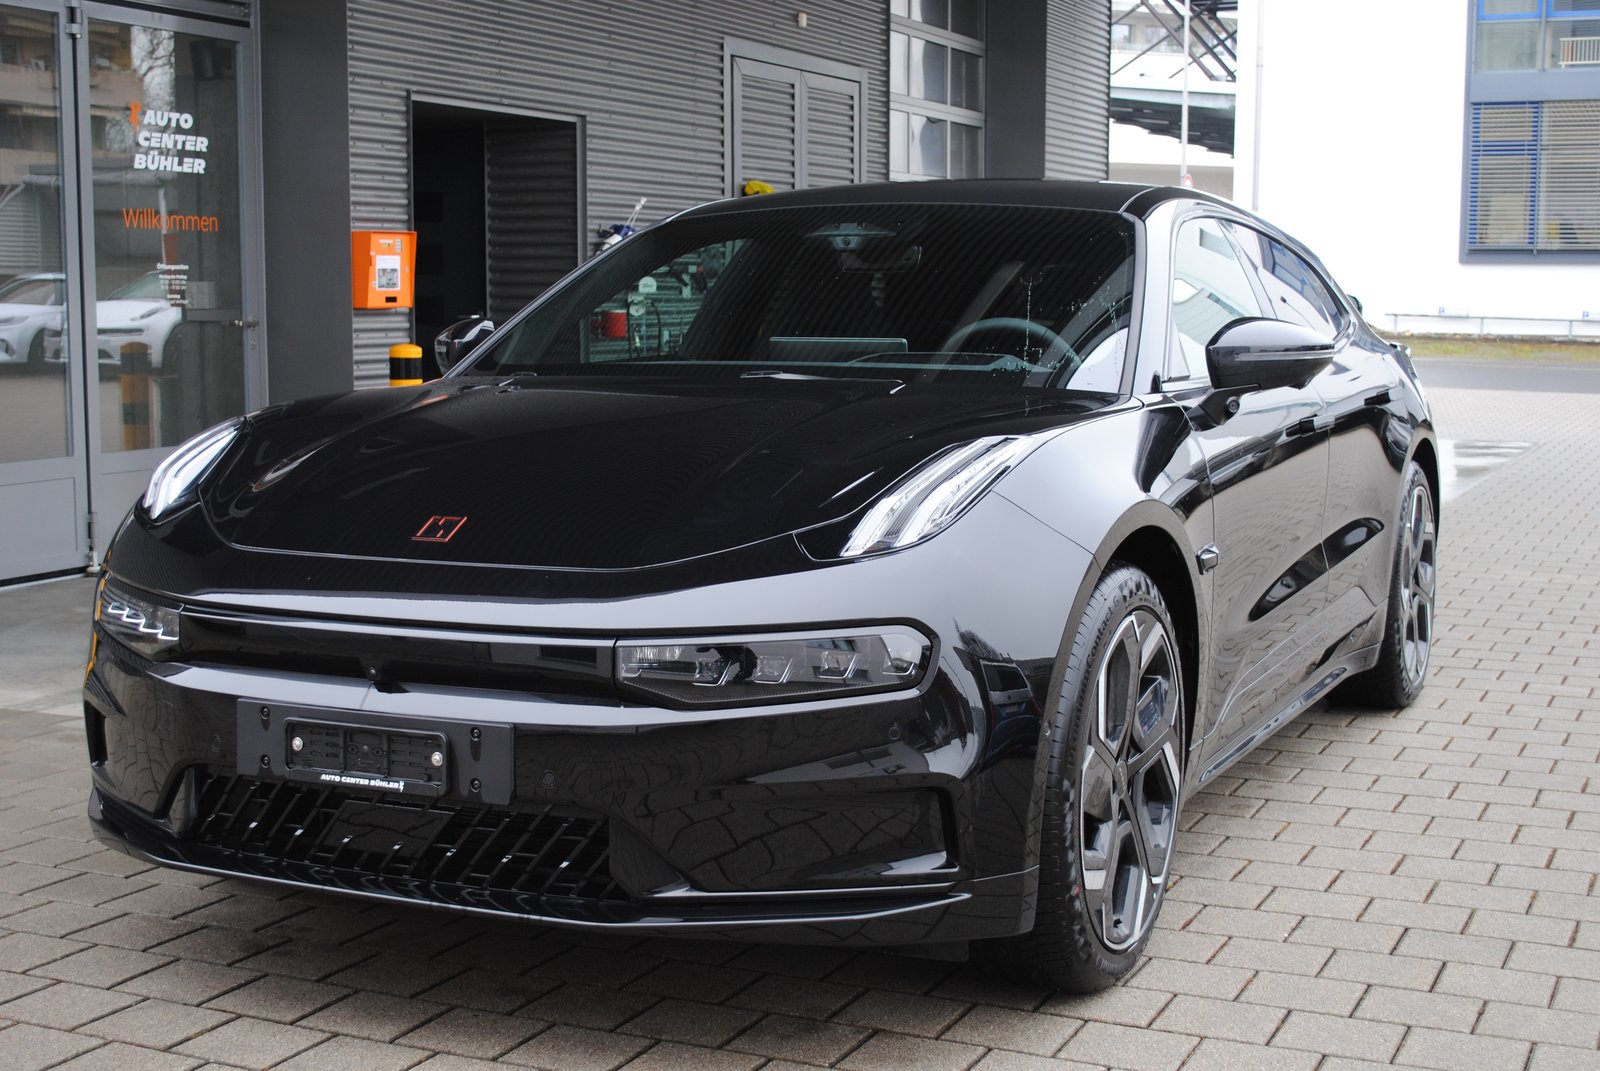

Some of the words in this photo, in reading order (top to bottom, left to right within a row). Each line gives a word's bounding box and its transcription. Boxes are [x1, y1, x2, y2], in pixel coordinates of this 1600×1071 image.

[143, 110, 193, 129] AUTO
[138, 131, 208, 152] CENTER
[133, 151, 206, 174] BÜHLER
[122, 207, 219, 232] Willkommen
[341, 776, 370, 785] CENTER
[370, 779, 400, 788] BÜHLER
